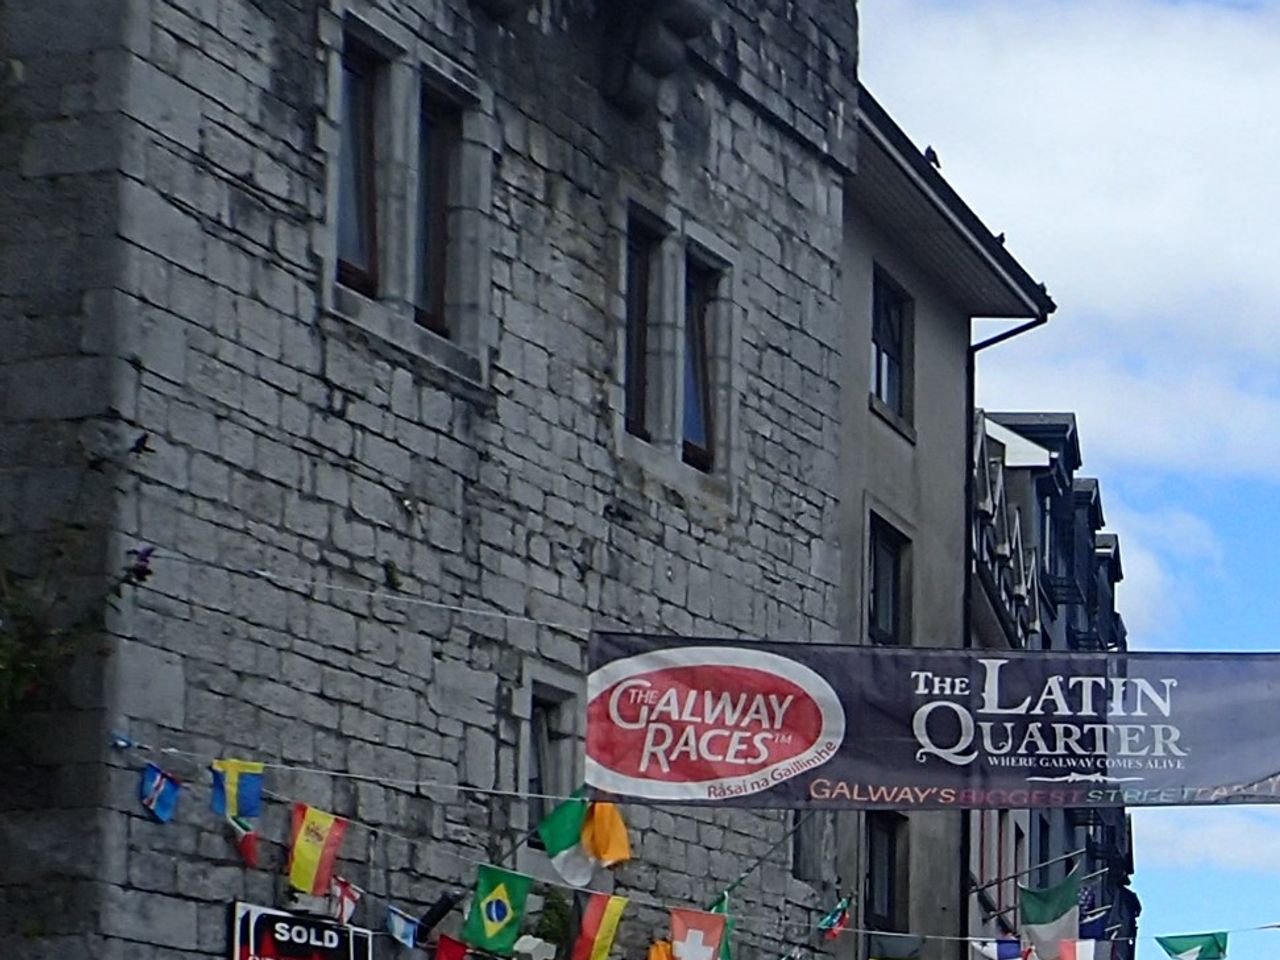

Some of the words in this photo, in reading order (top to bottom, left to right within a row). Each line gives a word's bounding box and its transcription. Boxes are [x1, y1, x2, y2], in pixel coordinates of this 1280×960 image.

[609, 678, 794, 730] GALWAY
[628, 688, 657, 705] THE
[911, 671, 970, 697] THE
[977, 659, 1179, 717] LATIN
[639, 722, 773, 774] RACES
[912, 701, 1189, 766] QUARTER
[750, 778, 769, 791] na
[770, 740, 837, 782] Gaillimhe
[988, 756, 1036, 767] WHERE
[1039, 756, 1094, 768] GALWAY
[1096, 758, 1143, 769] COMES
[1144, 758, 1184, 769] ALIVE
[810, 778, 955, 804] GALWAY'S
[274, 922, 339, 948] SOLD
